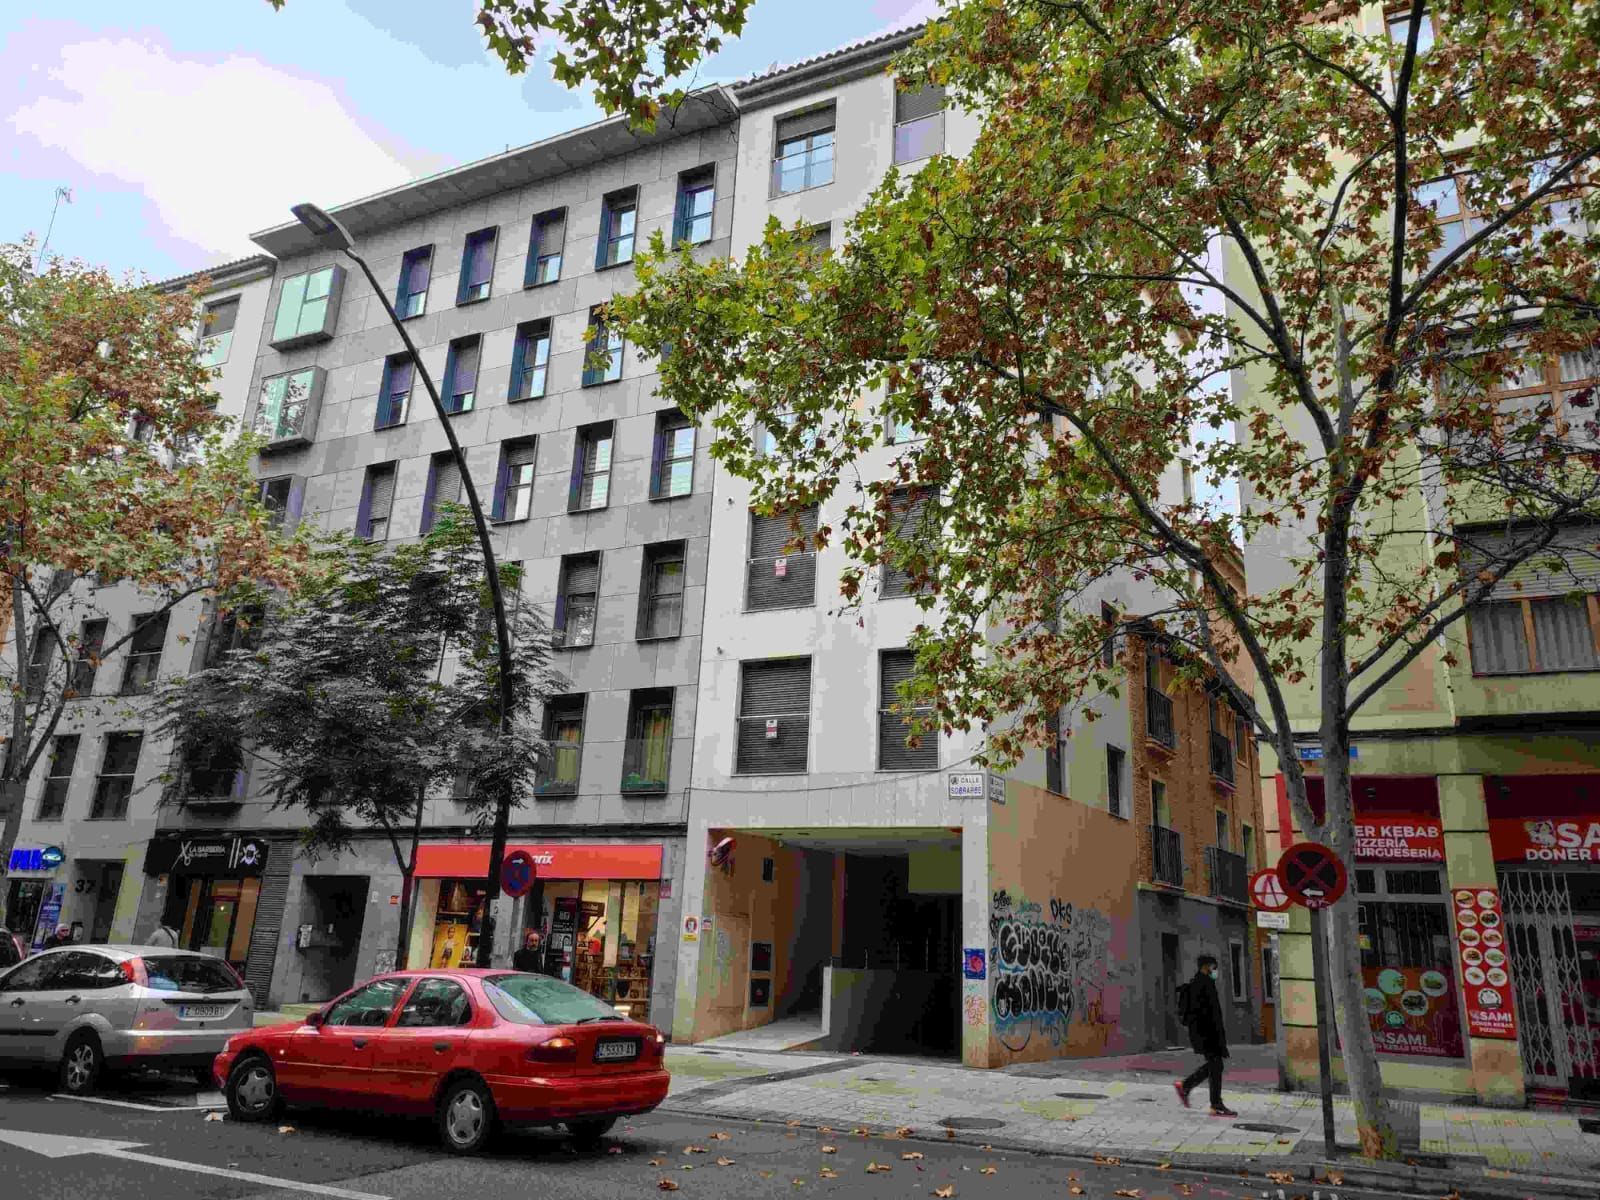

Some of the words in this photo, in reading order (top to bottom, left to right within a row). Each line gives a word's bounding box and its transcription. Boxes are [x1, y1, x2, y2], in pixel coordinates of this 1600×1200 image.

[1379, 825, 1439, 838] KEBAB
[1525, 845, 1593, 861] DÖNER
[75, 879, 95, 894] 37
[1479, 1011, 1512, 1022] SAMI
[1386, 1031, 1427, 1046] SAMI
